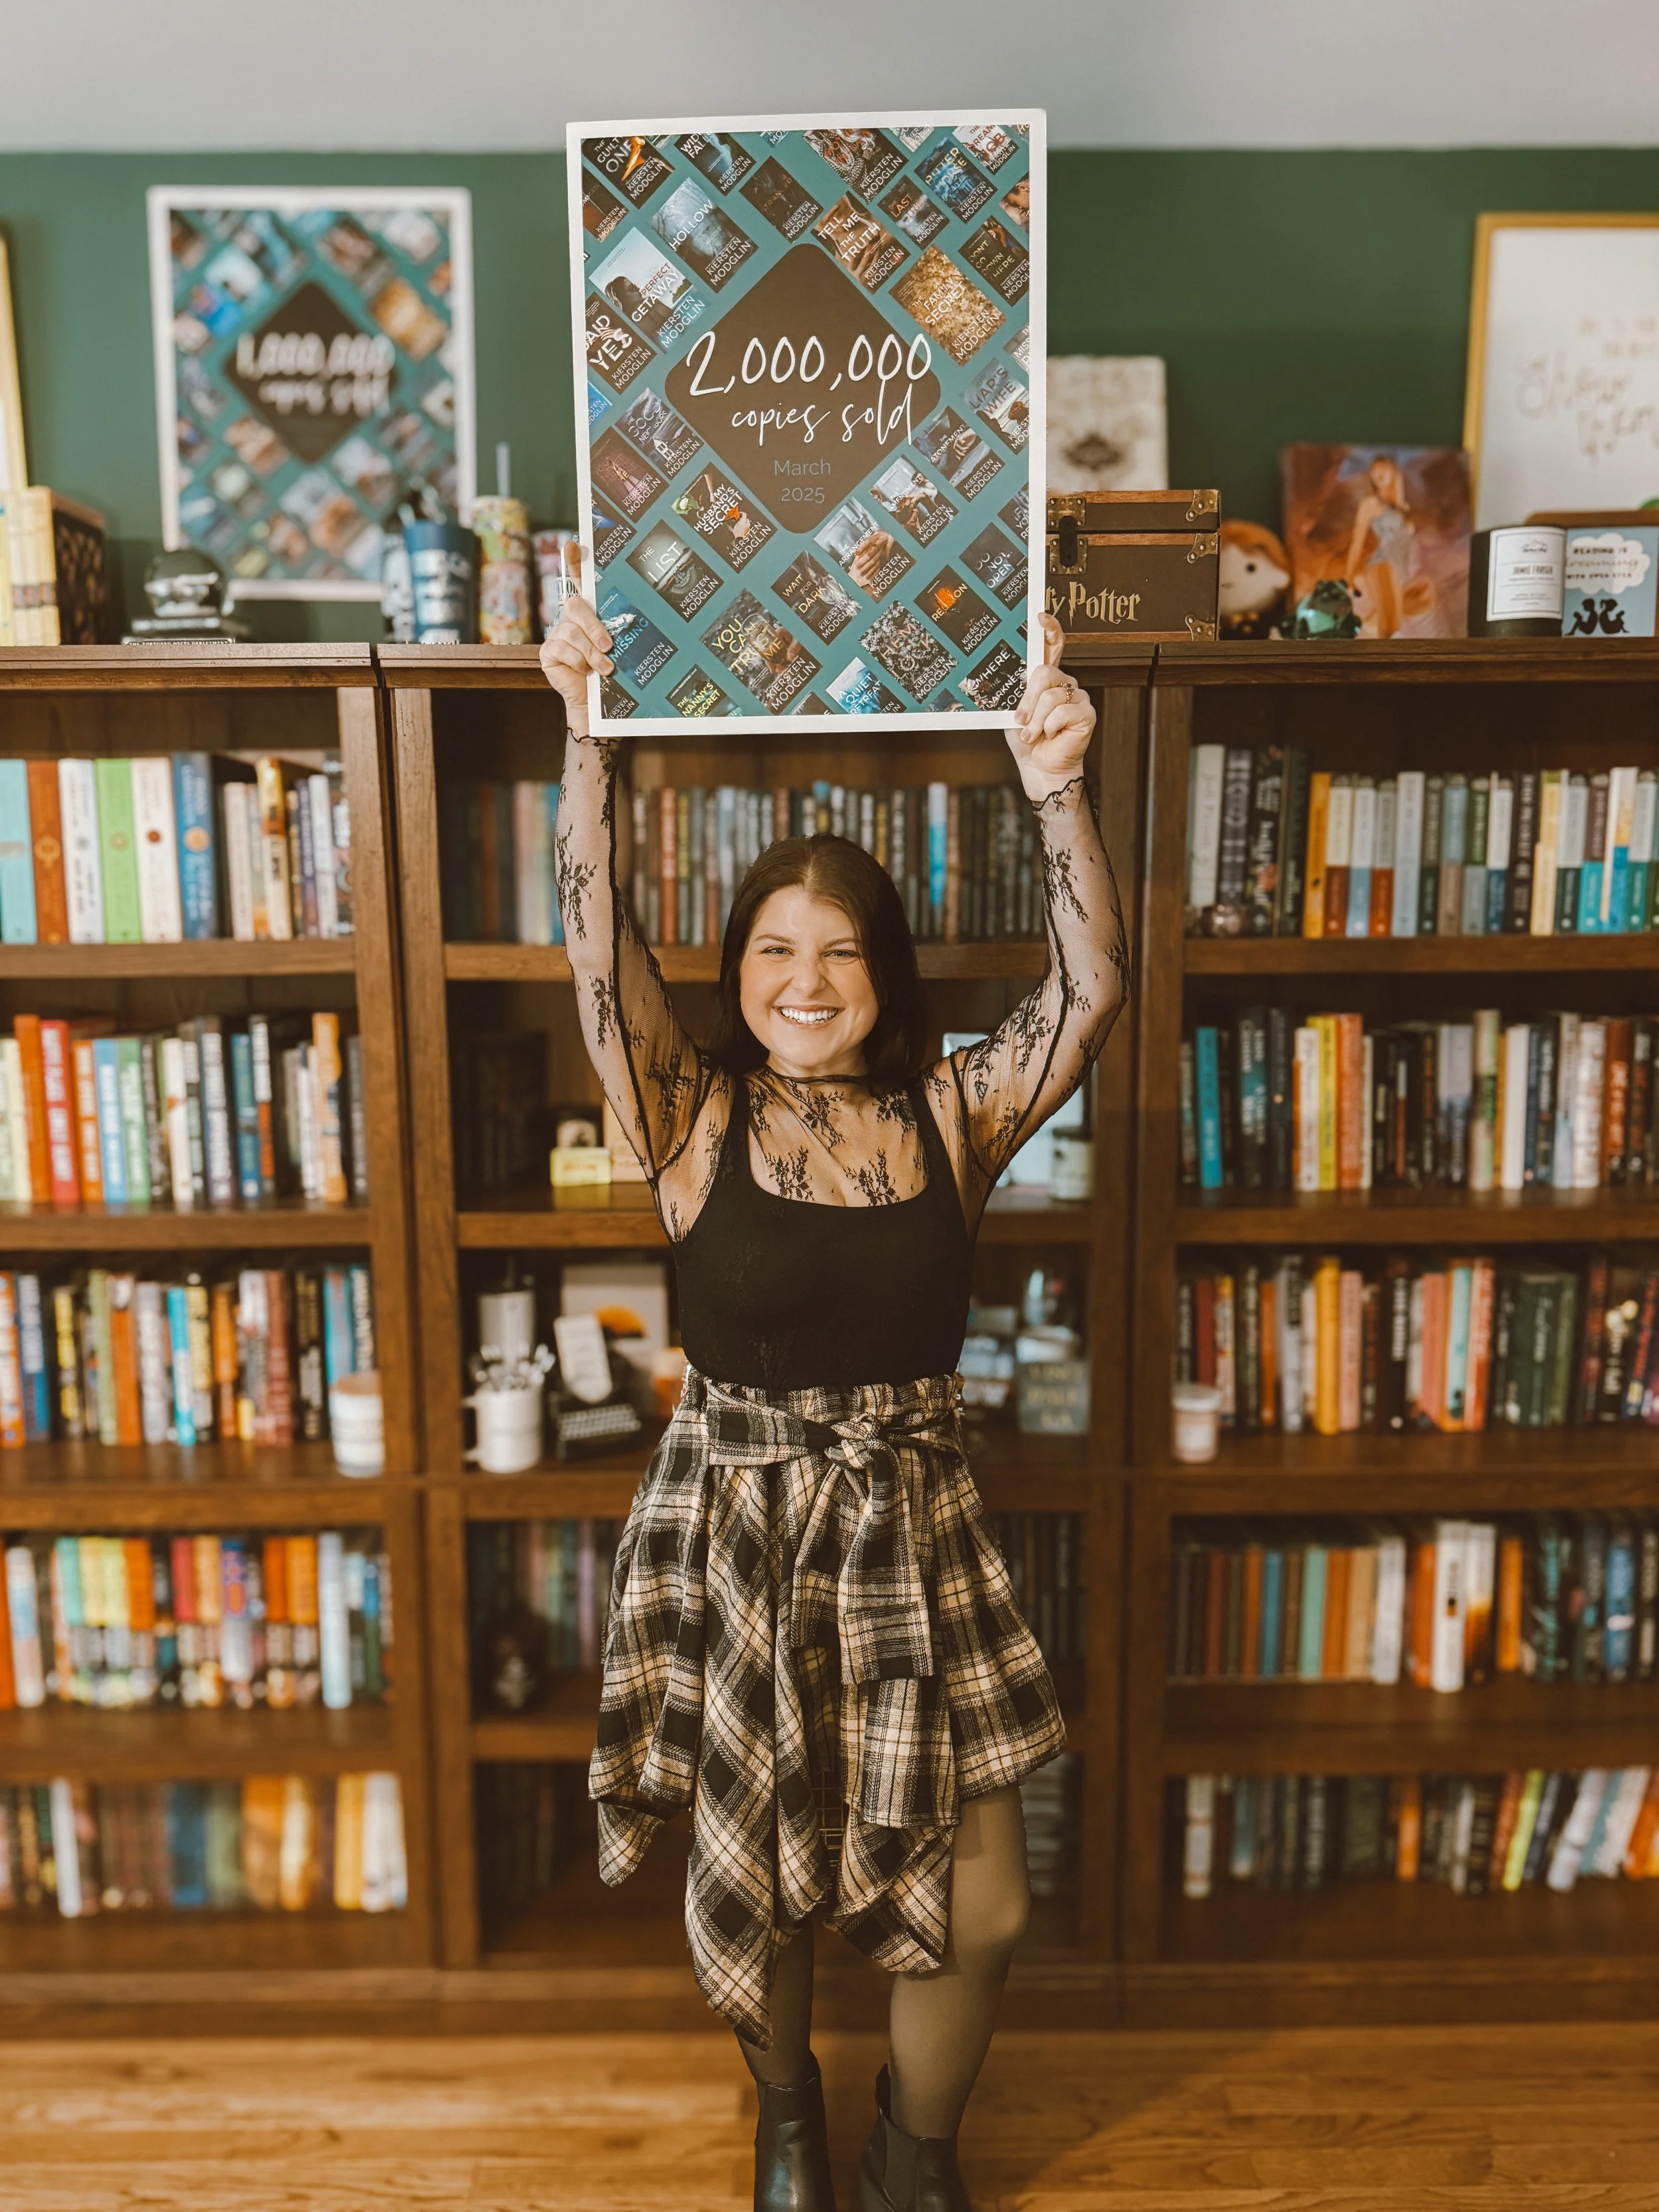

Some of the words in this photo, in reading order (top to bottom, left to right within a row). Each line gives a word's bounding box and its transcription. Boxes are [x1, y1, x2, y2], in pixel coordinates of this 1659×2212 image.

[606, 139, 632, 173] ONE
[680, 133, 702, 153] WID
[992, 145, 1015, 171] MODGLIN
[626, 157, 658, 190] KIERSTEN
[630, 160, 664, 199] MODGLIN
[718, 155, 745, 184] KIERSTEN
[721, 158, 751, 192] MODGLIN
[859, 153, 893, 189] KIERSTEN
[863, 157, 903, 198] MODGLIN
[925, 147, 961, 184] PITTER
[891, 194, 913, 217] LAST
[959, 185, 986, 212] KIERSTEN
[962, 187, 993, 220] MODGLIN
[596, 206, 620, 233] KIERSTEN
[599, 208, 626, 240] MODGLIN
[669, 200, 713, 250] HOLLOW
[784, 201, 811, 231] KIERSTEN
[787, 204, 819, 239] MODGLIN
[818, 209, 843, 240] TELL
[842, 211, 861, 232] ME
[914, 212, 938, 237] KIERSTEN
[916, 214, 944, 244] MODGLIN
[707, 237, 741, 275] KIERSTEN
[839, 231, 856, 248] THE
[841, 222, 881, 261] TRUTH
[642, 263, 672, 296] PERFECT
[710, 241, 751, 285] MODGLIN
[865, 246, 895, 279] KIERSTEN
[867, 249, 904, 289] MODGLIN
[1002, 261, 1029, 291] KIERSTEN
[631, 269, 679, 322] GETAWAY
[912, 296, 924, 308] THE
[923, 277, 954, 310] FAMILY
[926, 281, 966, 325] SECRET
[657, 295, 695, 337] KIERSTEN
[661, 299, 705, 348] MODGLIN
[952, 309, 989, 348] KIERSTEN
[956, 313, 999, 360] MODGLIN
[612, 346, 643, 380] KIERSTEN
[615, 349, 652, 389] MODGLIN
[687, 331, 931, 397] 2,000,000
[732, 403, 831, 446] copies
[842, 380, 912, 445] sold
[985, 381, 1016, 414] WIFE
[664, 438, 693, 469] KIERSTEN
[667, 441, 700, 477] MODGLIN
[930, 424, 966, 463] ATONEMENT
[774, 459, 831, 477] March
[964, 458, 994, 490] KIERSTEN
[966, 461, 1002, 499] MODGLIN
[624, 474, 653, 506] KIERSTEN
[627, 478, 662, 515] MODGLIN
[713, 484, 726, 498] MY
[782, 487, 825, 504] 2025
[694, 486, 735, 532] HUSBAND'S
[703, 490, 742, 535] SECRET
[917, 504, 946, 535] KIERSTEN
[920, 507, 954, 544] MODGLIN
[595, 524, 624, 557] KIERSTEN
[598, 528, 632, 565] MODGLIN
[639, 546, 655, 562] THE
[729, 521, 762, 558] KIERSTEN
[733, 525, 771, 567] MODGLIN
[839, 521, 879, 566] ARRANGEMENT
[839, 544, 849, 554] THE
[648, 542, 683, 582] LIST
[869, 553, 902, 588] KIERSTEN
[873, 557, 910, 597] MODGLIN
[987, 563, 1012, 589] OPEN
[680, 575, 710, 609] KIERSTEN
[683, 578, 719, 619] MODGLIN
[782, 573, 804, 597] WAIT
[800, 581, 813, 595] FOR
[1002, 567, 1029, 596] KIERSTEN
[798, 585, 826, 613] DARK
[819, 599, 848, 630] KIERSTEN
[1068, 581, 1141, 627] Potter
[712, 619, 743, 650] YOU
[822, 602, 855, 638] MODGLIN
[962, 614, 990, 644] KIERSTEN
[964, 617, 997, 652] MODGLIN
[609, 618, 649, 662] MISSING
[763, 637, 784, 659] ME
[634, 642, 665, 676] KIERSTEN
[638, 646, 674, 685] MODGLIN
[913, 656, 946, 690] KIERSTEN
[972, 650, 1010, 690] WHERE
[768, 658, 806, 699] KIERSTEN
[771, 661, 816, 710] MODGLIN
[839, 690, 848, 699] A
[845, 673, 874, 704] QUIET
[916, 659, 954, 699] MODGLIN
[986, 666, 1025, 709] DARKNESS
[678, 696, 689, 708] THE
[682, 682, 713, 717] NANNY'S
[694, 689, 721, 717] SECRET
